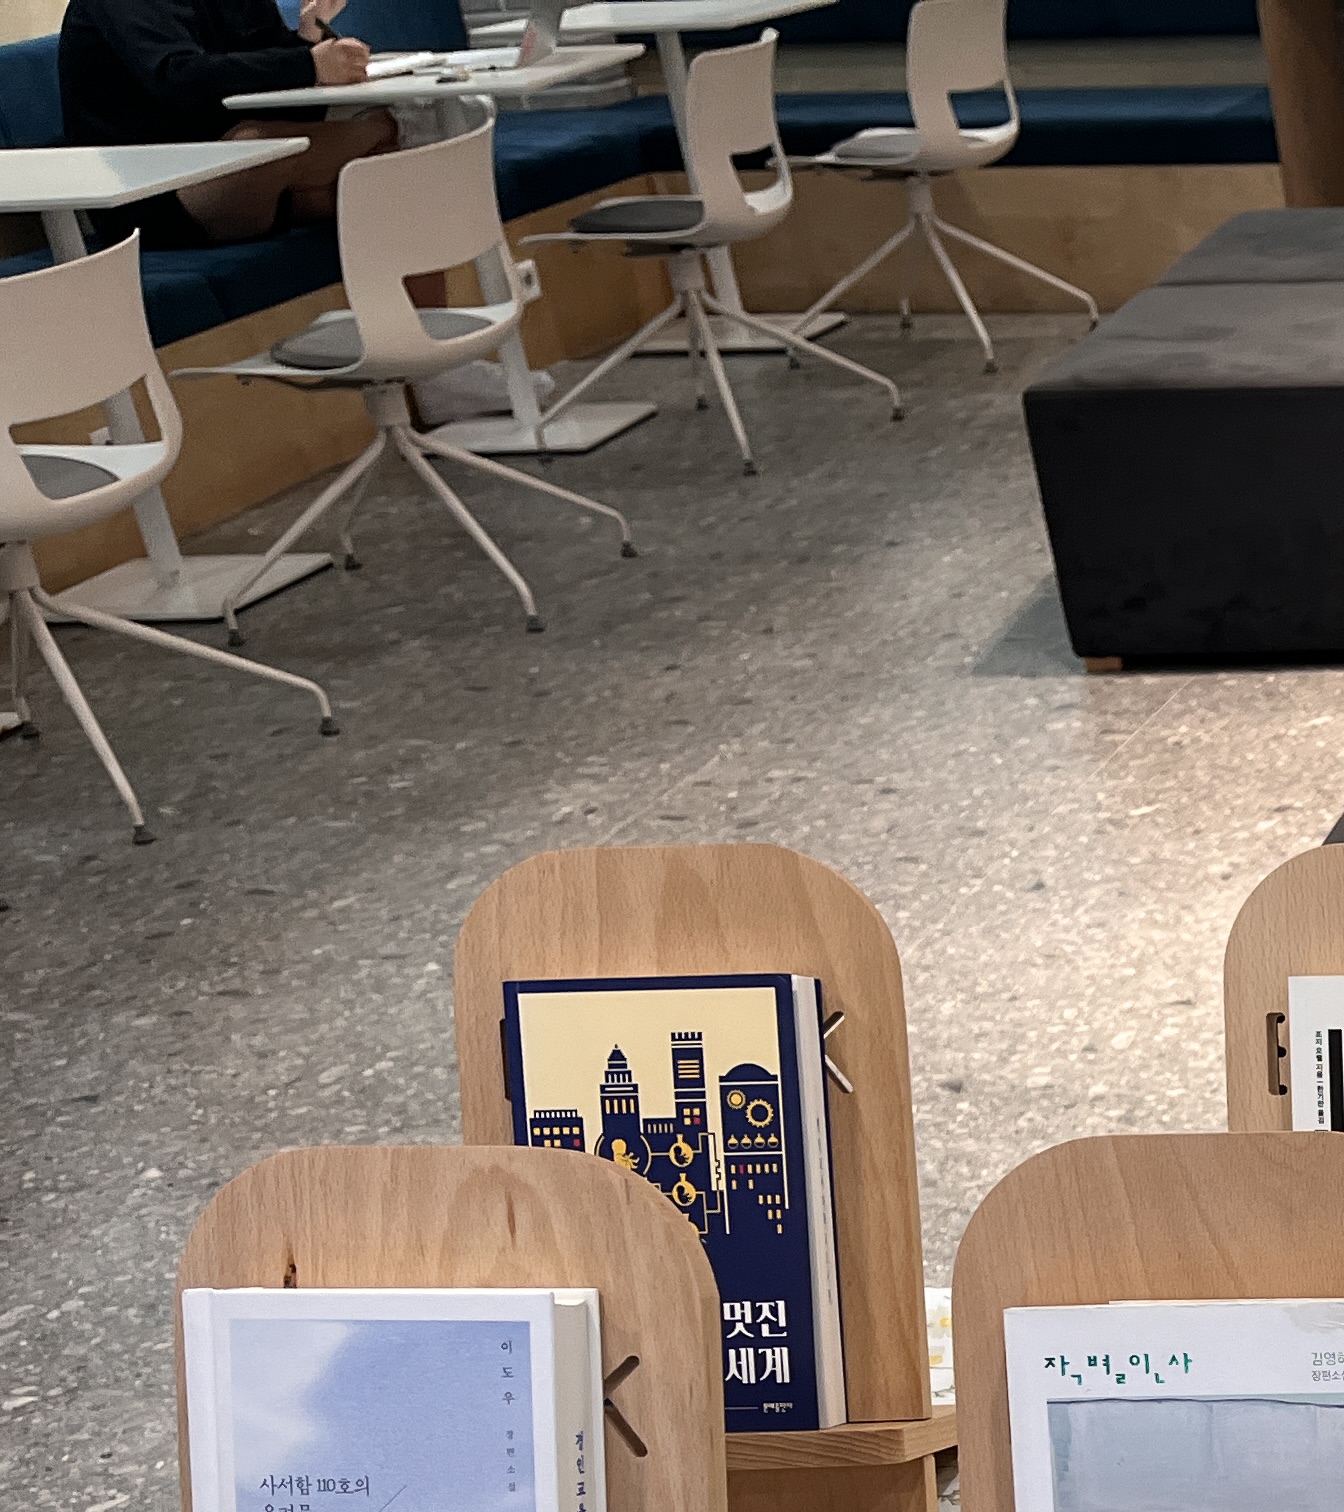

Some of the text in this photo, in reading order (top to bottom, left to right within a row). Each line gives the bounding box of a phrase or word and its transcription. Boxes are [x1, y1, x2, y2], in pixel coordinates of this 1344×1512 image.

[722, 1300, 788, 1338] 멋진
[725, 1347, 791, 1384] 세계
[1043, 1351, 1194, 1386] 작별인사
[260, 1475, 370, 1498] 사서함 110호의
